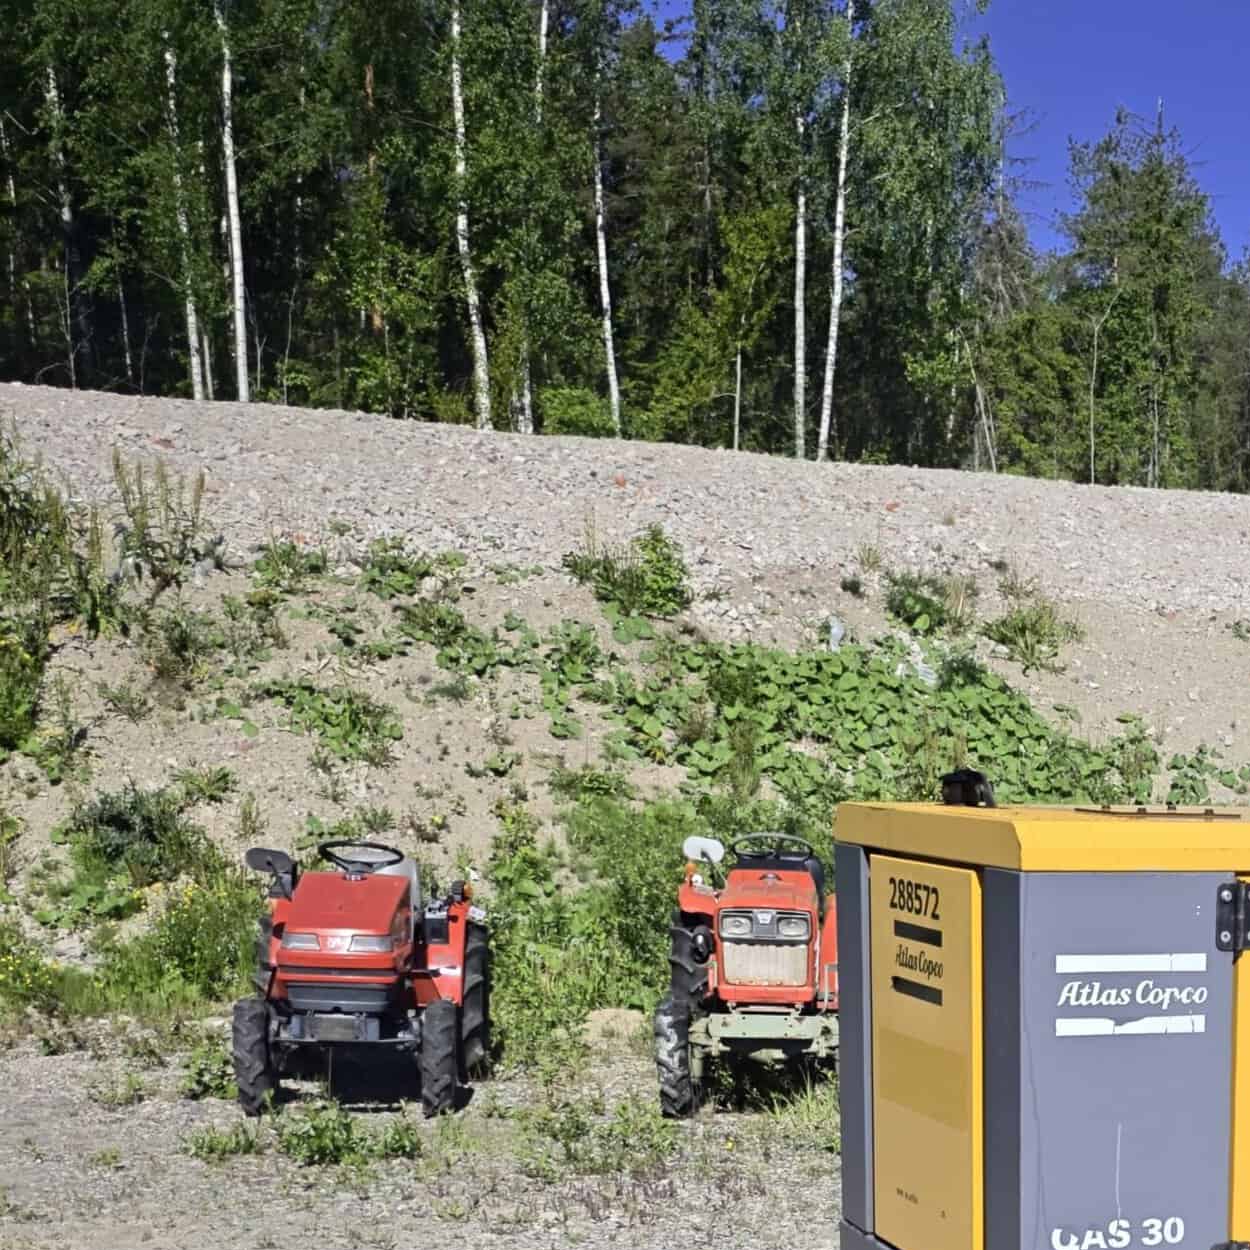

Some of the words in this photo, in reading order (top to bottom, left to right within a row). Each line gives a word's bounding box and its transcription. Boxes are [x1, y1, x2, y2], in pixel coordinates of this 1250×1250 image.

[889, 877, 940, 920] 288572
[896, 944, 918, 972] Atlas
[918, 950, 943, 980] Copco
[1057, 980, 1132, 1006] Atlas
[1135, 979, 1208, 1010] Copco
[1141, 1216, 1185, 1246] 30
